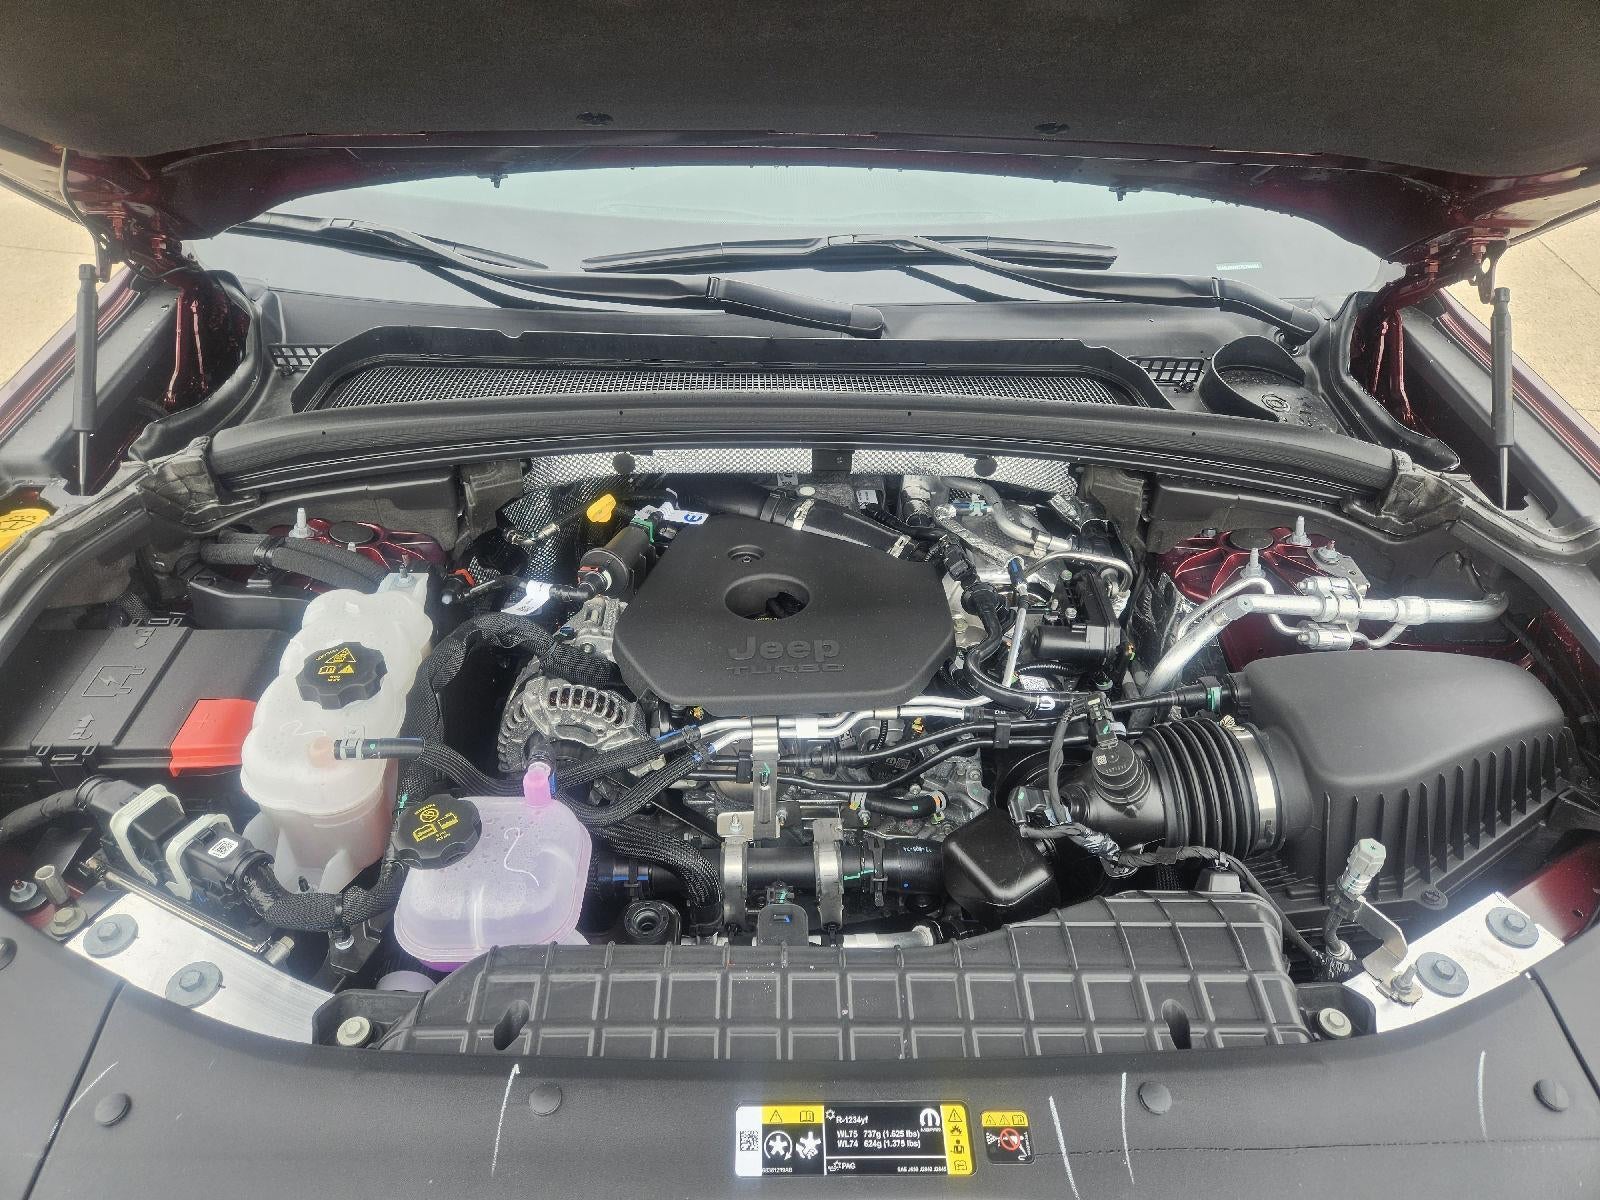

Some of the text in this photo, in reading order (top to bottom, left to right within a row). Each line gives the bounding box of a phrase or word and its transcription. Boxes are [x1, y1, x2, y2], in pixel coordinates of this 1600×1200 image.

[727, 636, 840, 662] Jeep
[726, 664, 845, 675] TURBO
[835, 1115, 869, 1125] R-1234yf
[836, 1130, 859, 1138] WL75
[863, 1130, 881, 1139] 737g
[905, 1130, 920, 1139] lbs)
[837, 1140, 859, 1148] WL74
[864, 1140, 882, 1149] 624g
[906, 1140, 921, 1149] lbs)
[841, 1162, 856, 1170] PAG
